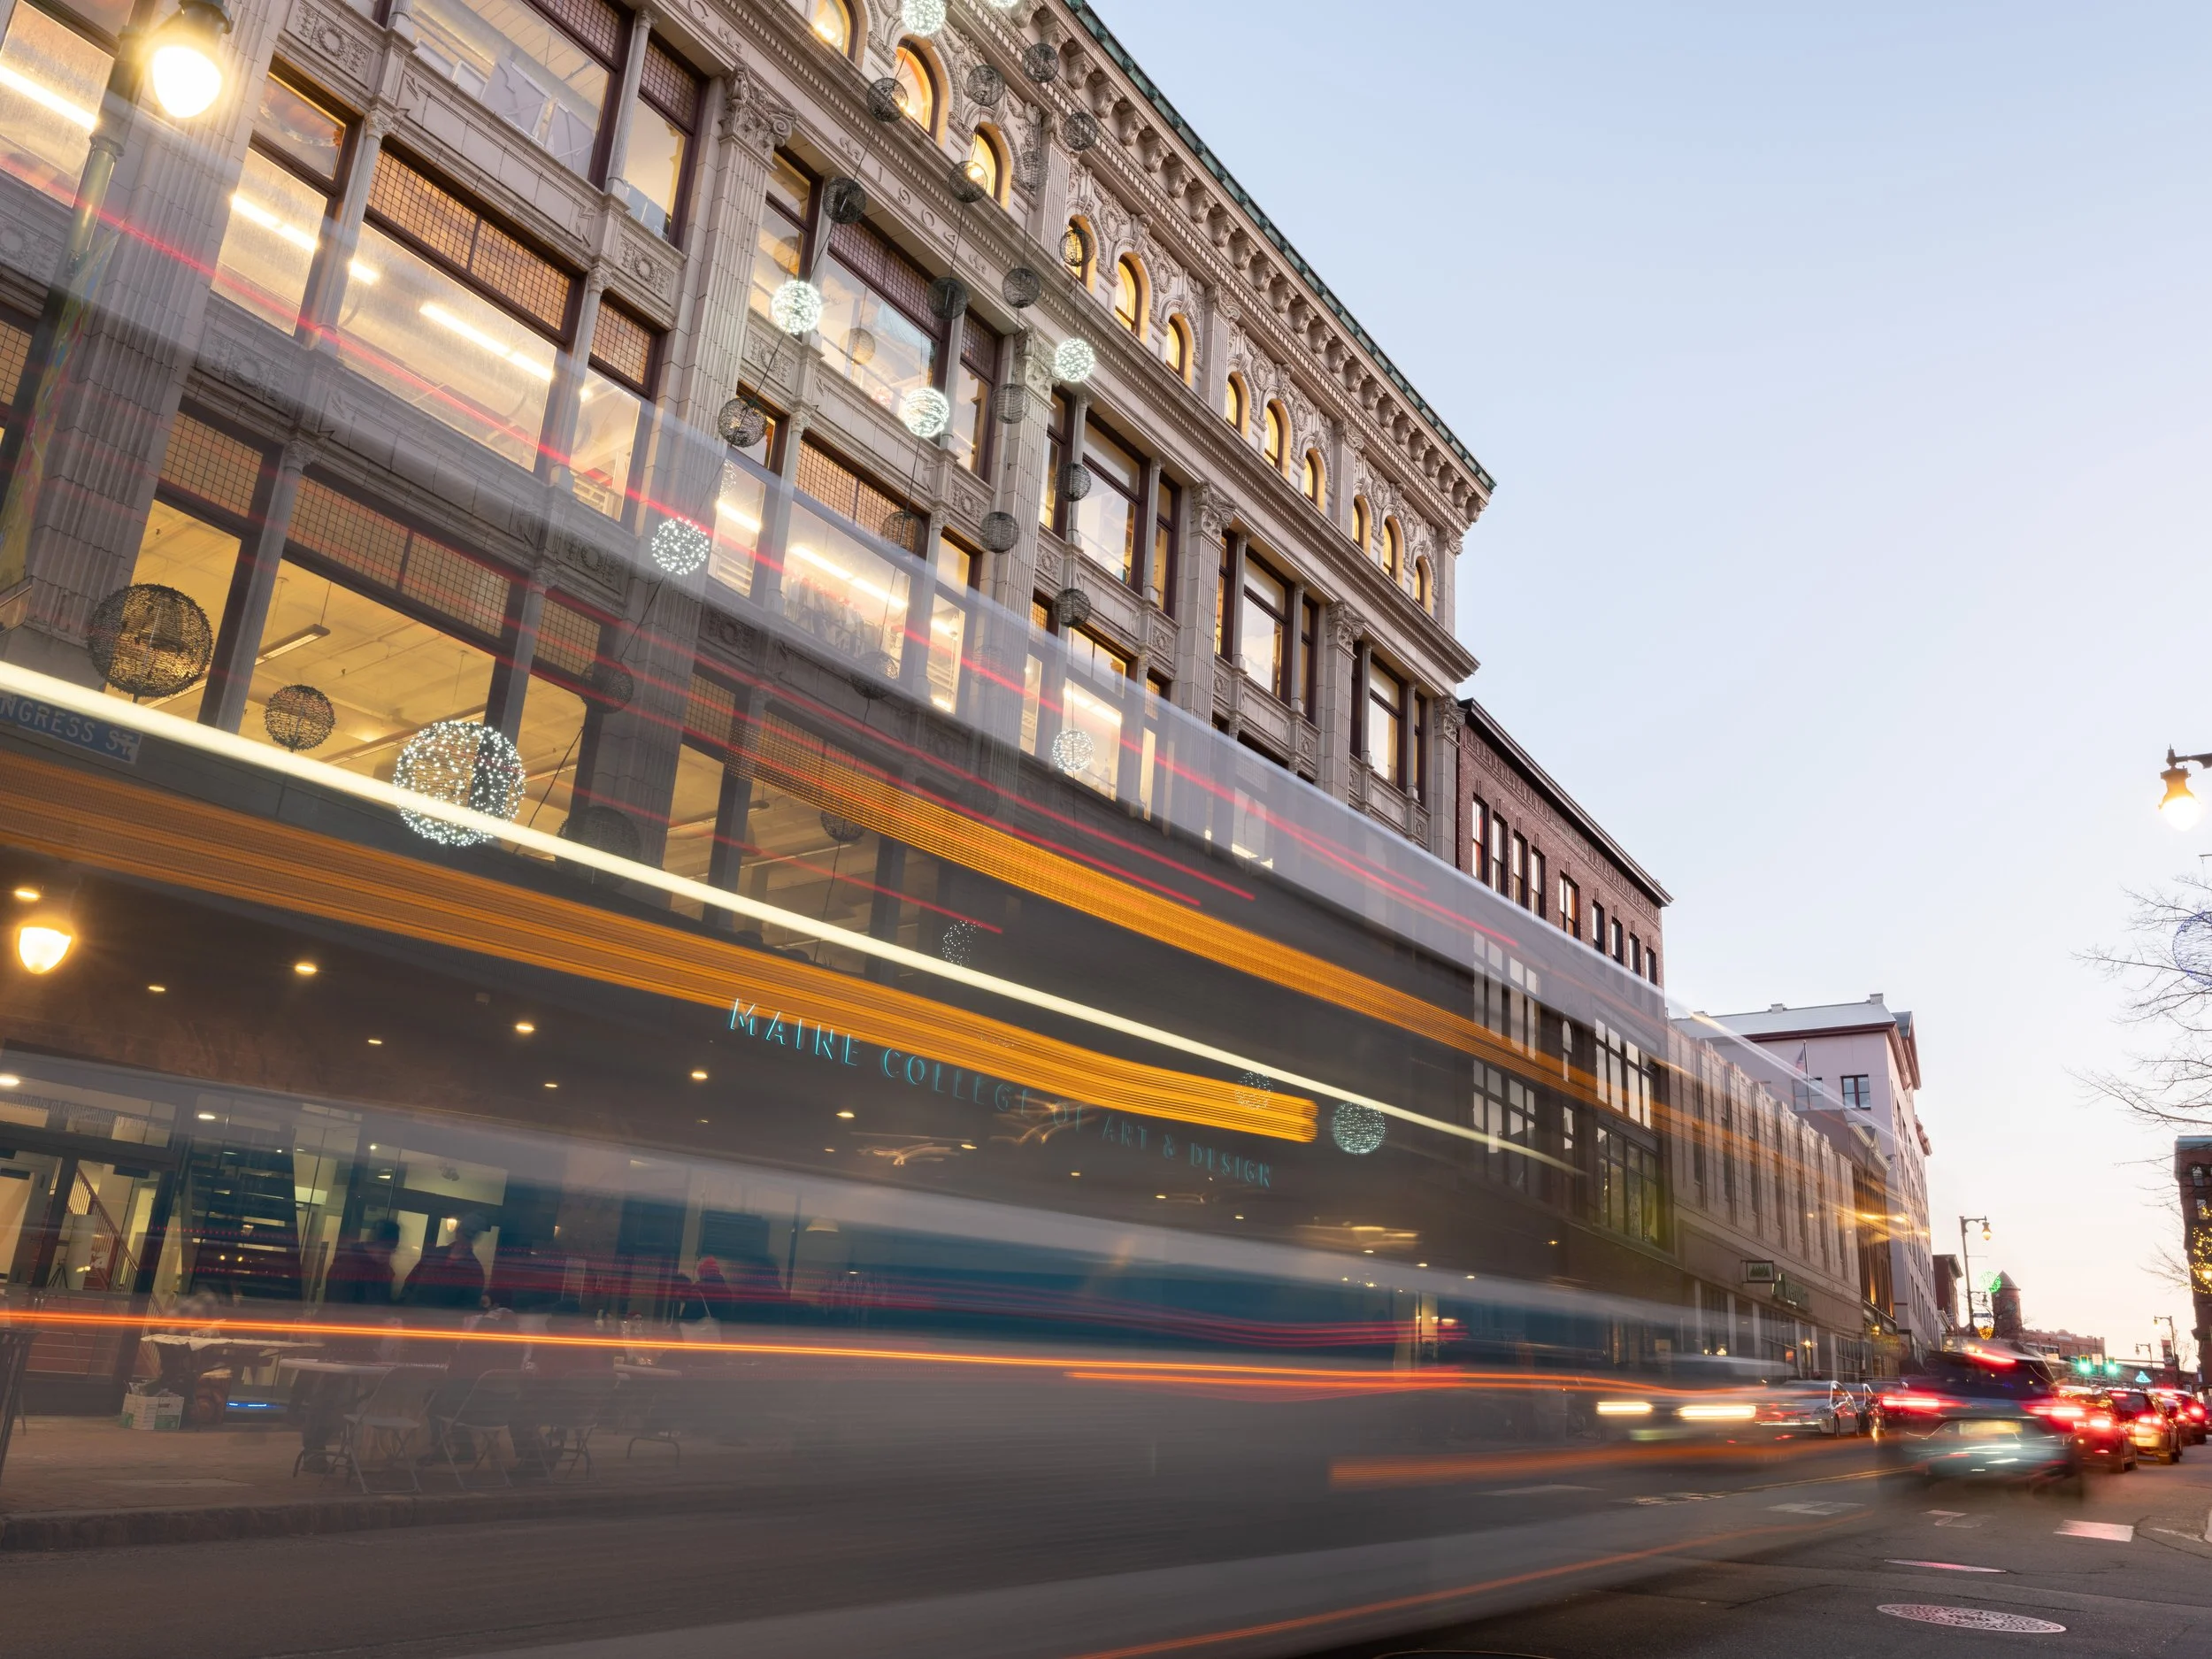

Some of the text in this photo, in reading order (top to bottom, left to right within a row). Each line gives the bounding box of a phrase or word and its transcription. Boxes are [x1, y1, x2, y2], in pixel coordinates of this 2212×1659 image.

[877, 165, 957, 248] 1904
[105, 730, 134, 756] ST
[729, 998, 860, 1066] MAINE
[1102, 1117, 1148, 1149] ART
[1163, 1133, 1177, 1160] &
